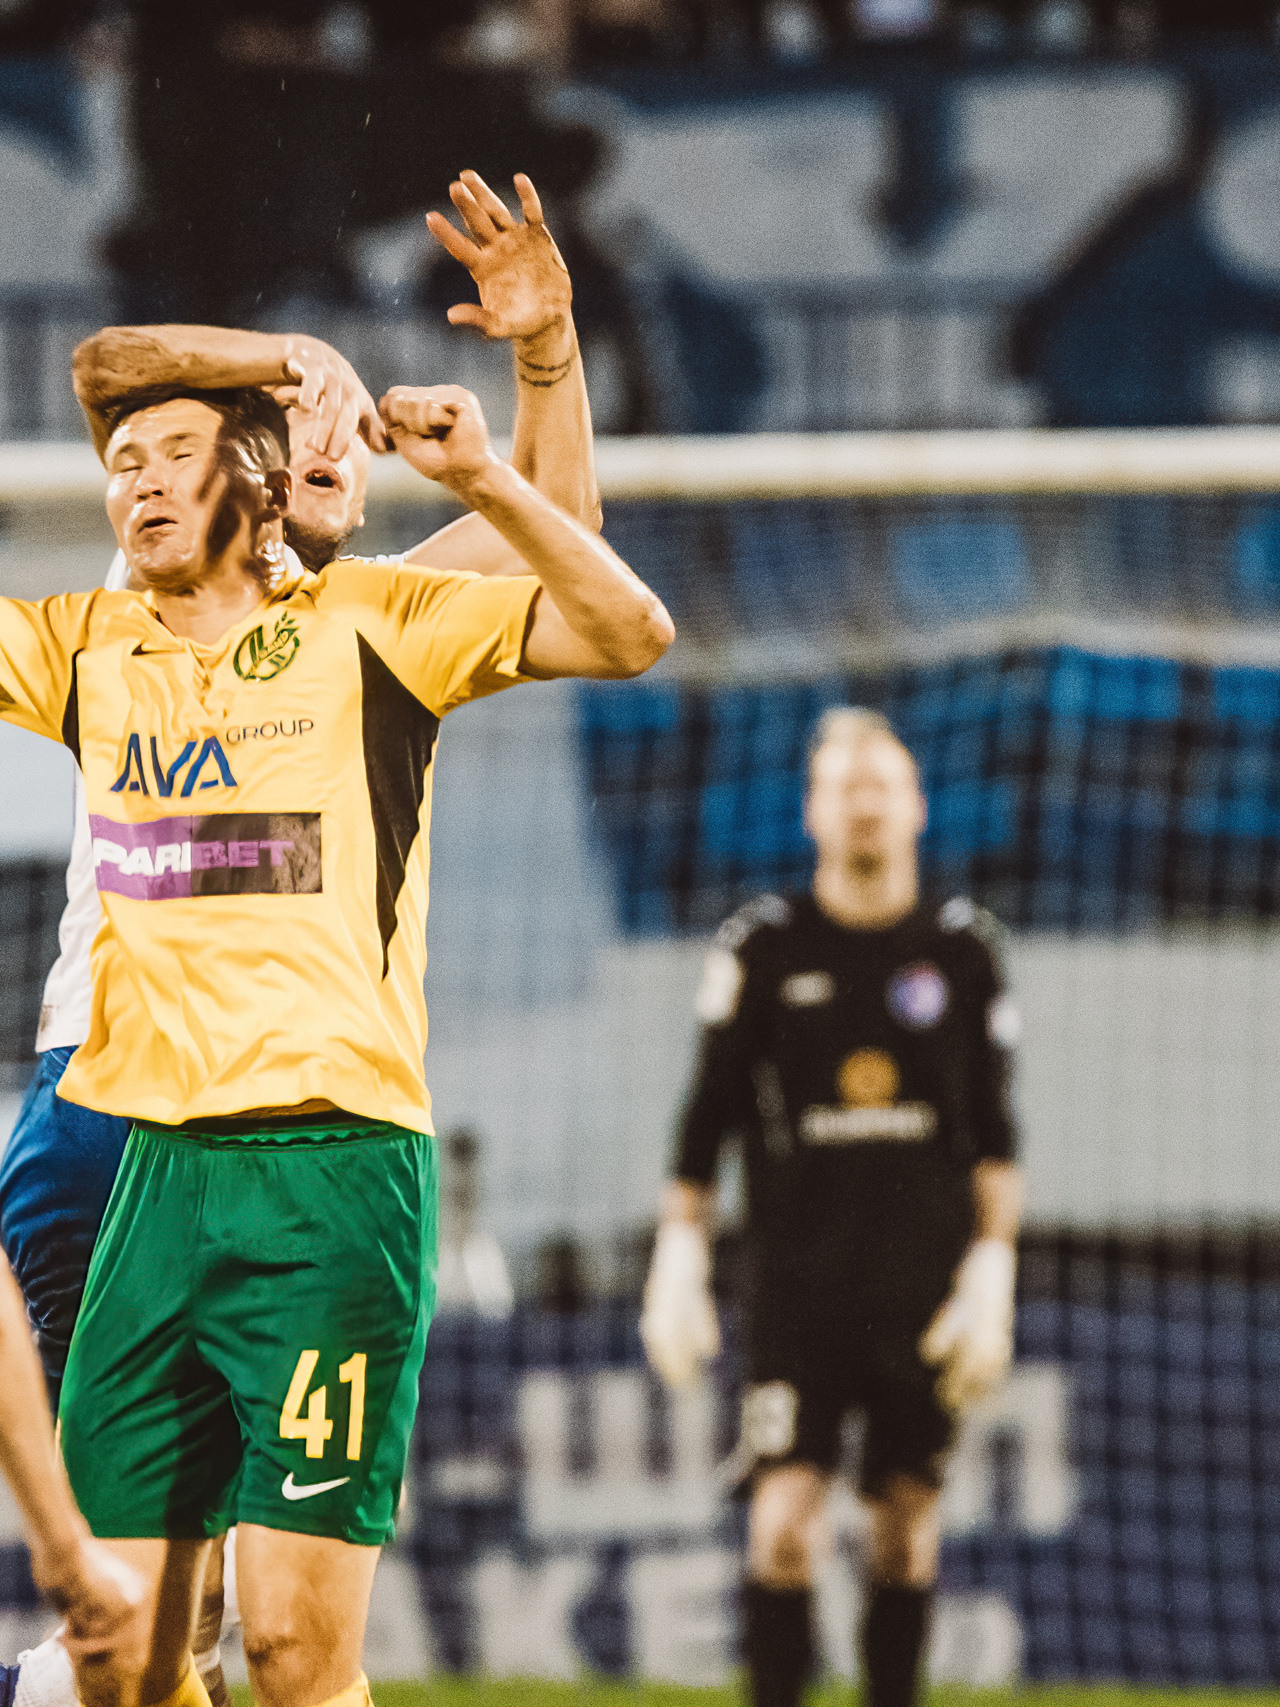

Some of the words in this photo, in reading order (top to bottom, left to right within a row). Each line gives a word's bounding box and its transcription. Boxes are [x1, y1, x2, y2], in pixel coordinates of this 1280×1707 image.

[110, 732, 239, 798] AVA
[225, 718, 315, 746] GROUP
[279, 1349, 368, 1462] 41
